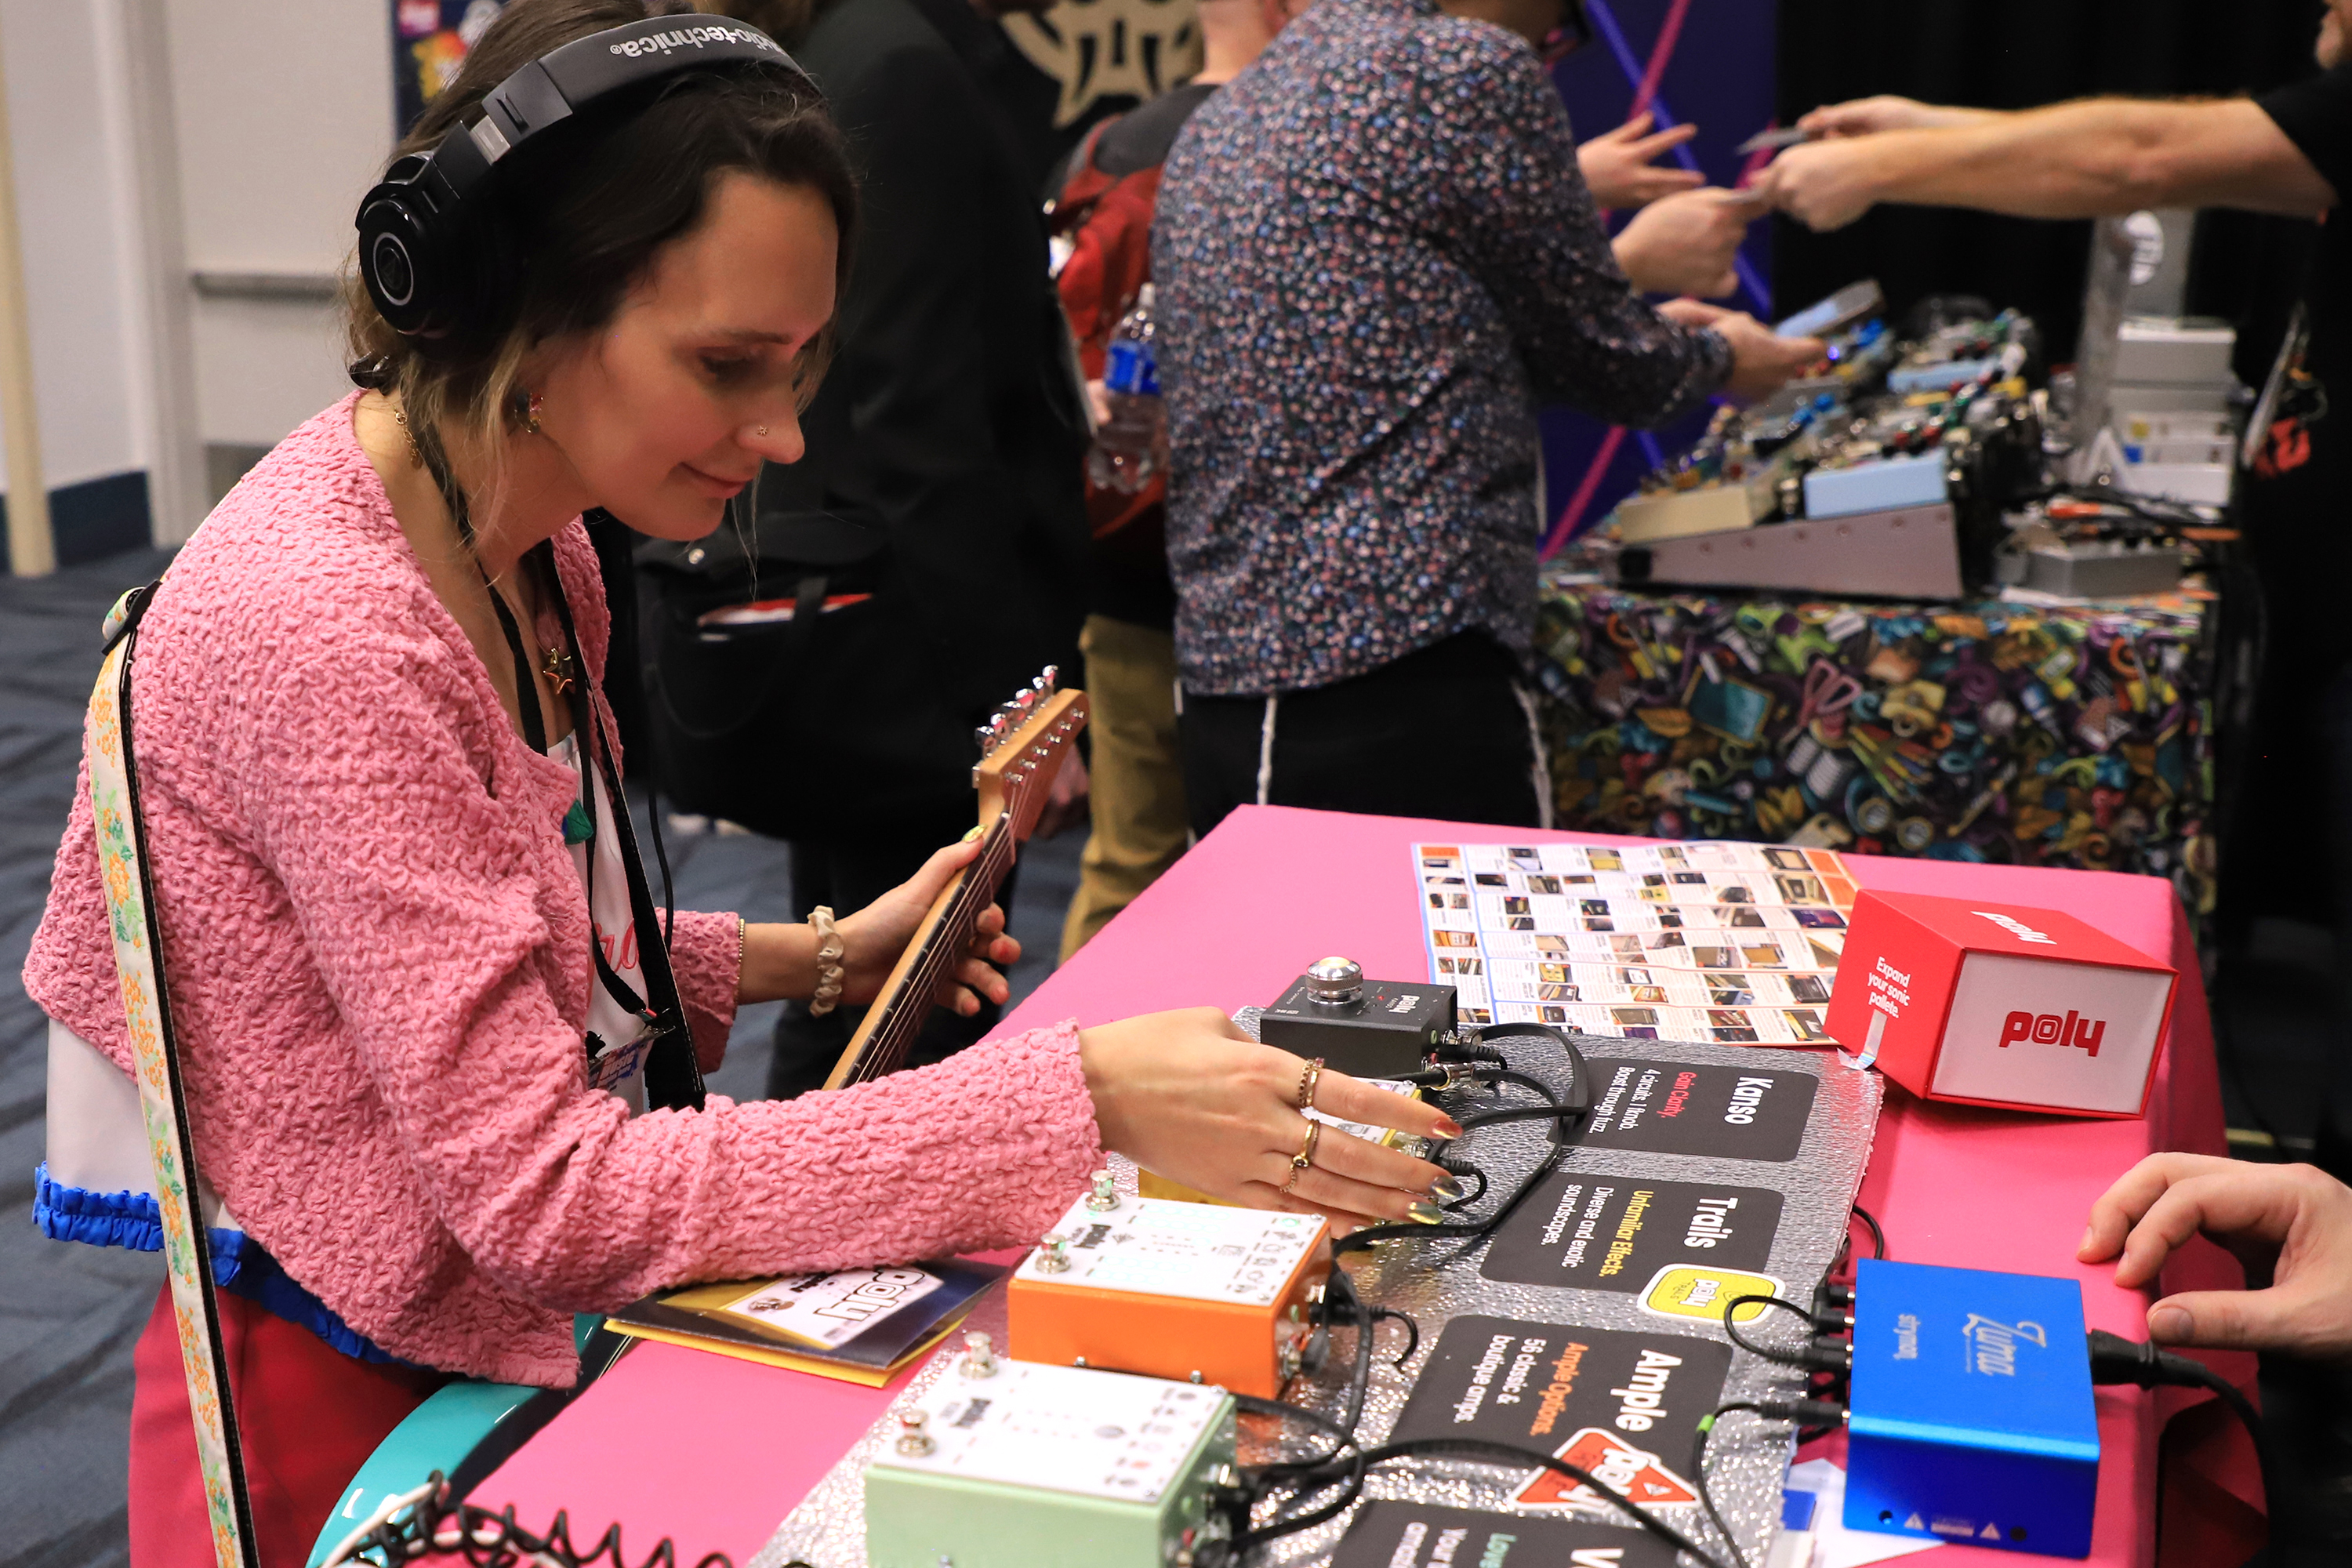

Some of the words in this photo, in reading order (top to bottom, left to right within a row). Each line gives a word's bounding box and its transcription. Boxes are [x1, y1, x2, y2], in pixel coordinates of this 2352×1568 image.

[1970, 910, 2058, 945] poly
[1876, 956, 1911, 988] Expand
[1388, 995, 1421, 1014] poly
[1867, 972, 1889, 992] your
[1886, 985, 1911, 1007] sonic
[1868, 992, 1900, 1018] pallete.
[1998, 1009, 2107, 1057] poly
[1610, 1066, 1636, 1087] Boost
[1631, 1074, 1658, 1102] circuits.
[1673, 1072, 1697, 1091] Gain
[1593, 1086, 1627, 1116] through
[1657, 1091, 1690, 1118] Clarity.
[1724, 1076, 1774, 1124] Kanso
[1588, 1115, 1614, 1134] fuzz.
[1541, 1184, 1583, 1246] soundscapes.
[1583, 1186, 1615, 1220] Diverse
[1615, 1190, 1654, 1241] Unfamiliar
[1574, 1219, 1597, 1240] and
[1683, 1197, 1739, 1249] Trails
[1561, 1239, 1588, 1269] exotic
[1599, 1240, 1634, 1277] Effects.
[1678, 1278, 1722, 1308] poly
[1472, 1334, 1516, 1386] boutique
[1520, 1338, 1547, 1354] 56
[1962, 1313, 2047, 1376] Zuma
[1501, 1353, 1537, 1394] classic
[1552, 1341, 1590, 1383] Ample
[1453, 1385, 1487, 1424] amps.
[1496, 1392, 1521, 1405] &
[1610, 1349, 1683, 1432] Ample
[1530, 1382, 1573, 1436] Options.
